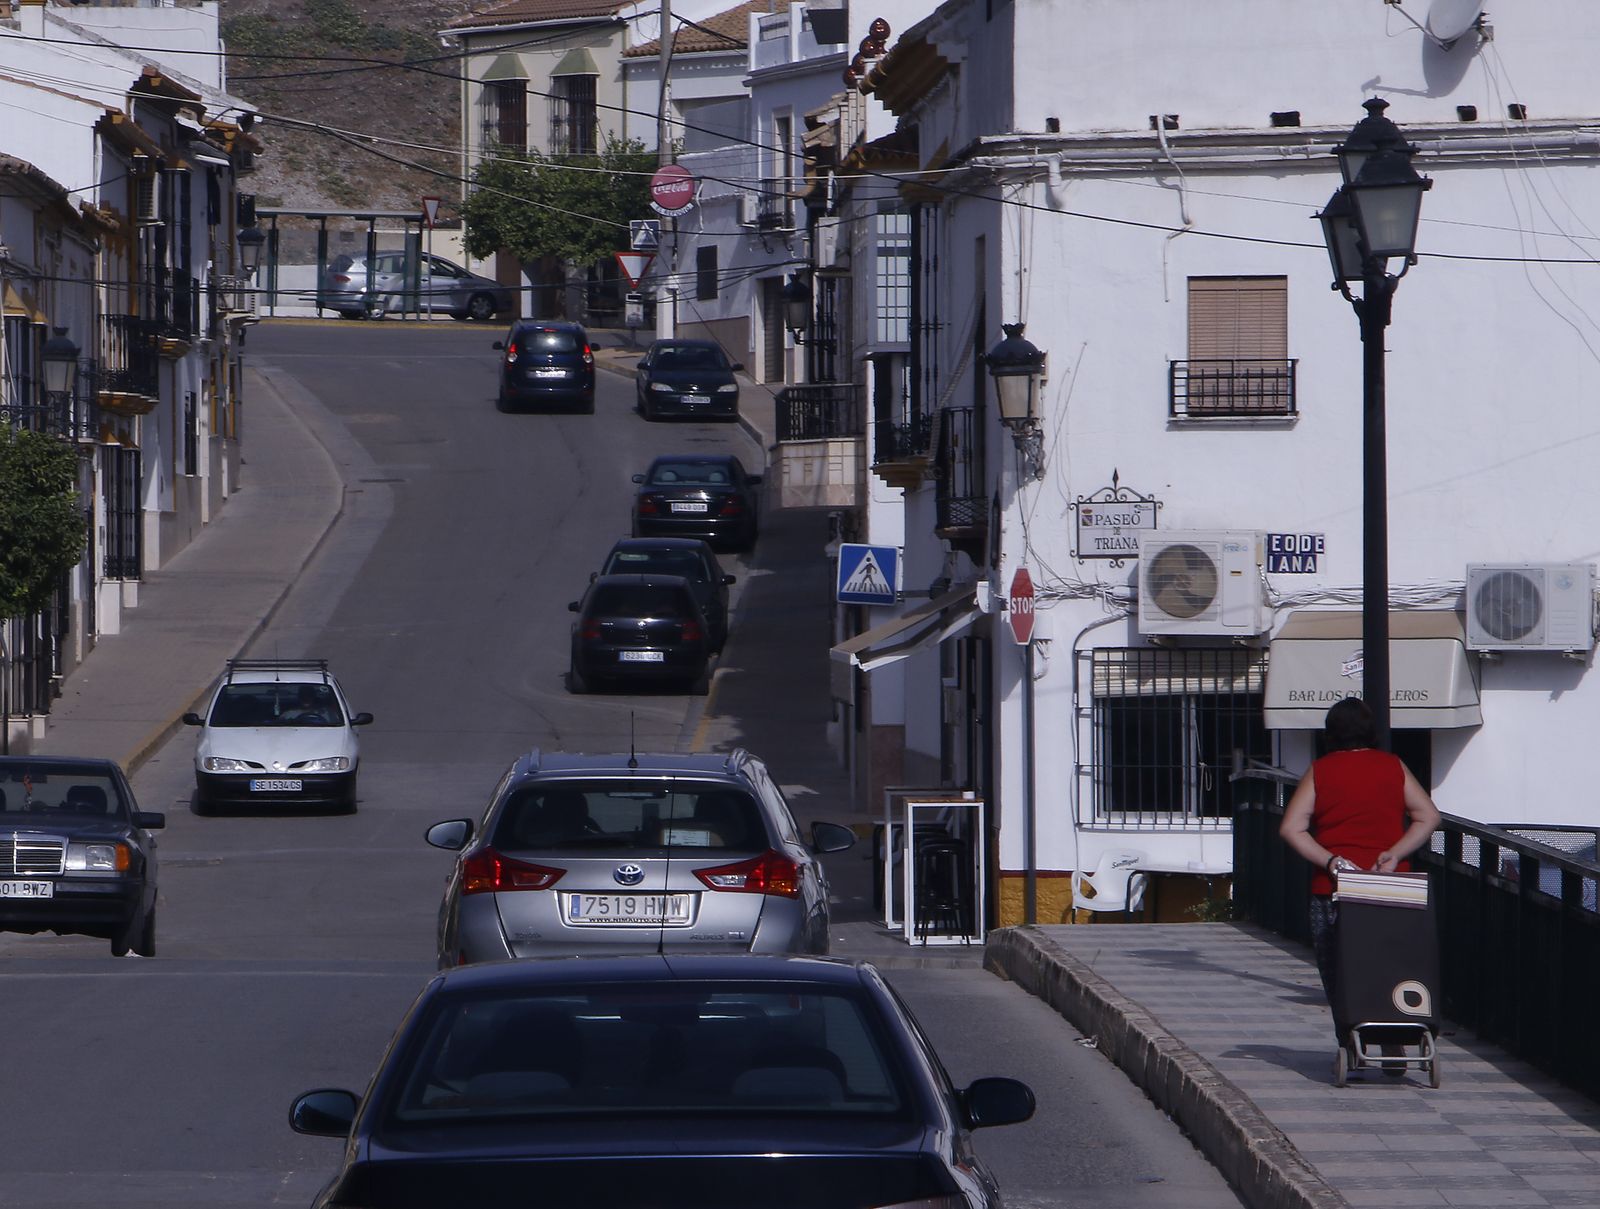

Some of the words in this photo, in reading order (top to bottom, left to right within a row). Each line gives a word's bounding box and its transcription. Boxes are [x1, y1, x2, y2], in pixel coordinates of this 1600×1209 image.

[1094, 513, 1141, 526] PASEO
[1094, 537, 1139, 550] TRIANA
[1011, 597, 1034, 614] STOP
[1289, 690, 1316, 702] BAR
[1318, 690, 1343, 702] LOS
[1345, 689, 1430, 702] COEROS
[255, 781, 266, 790] SE
[585, 897, 636, 915] 7519
